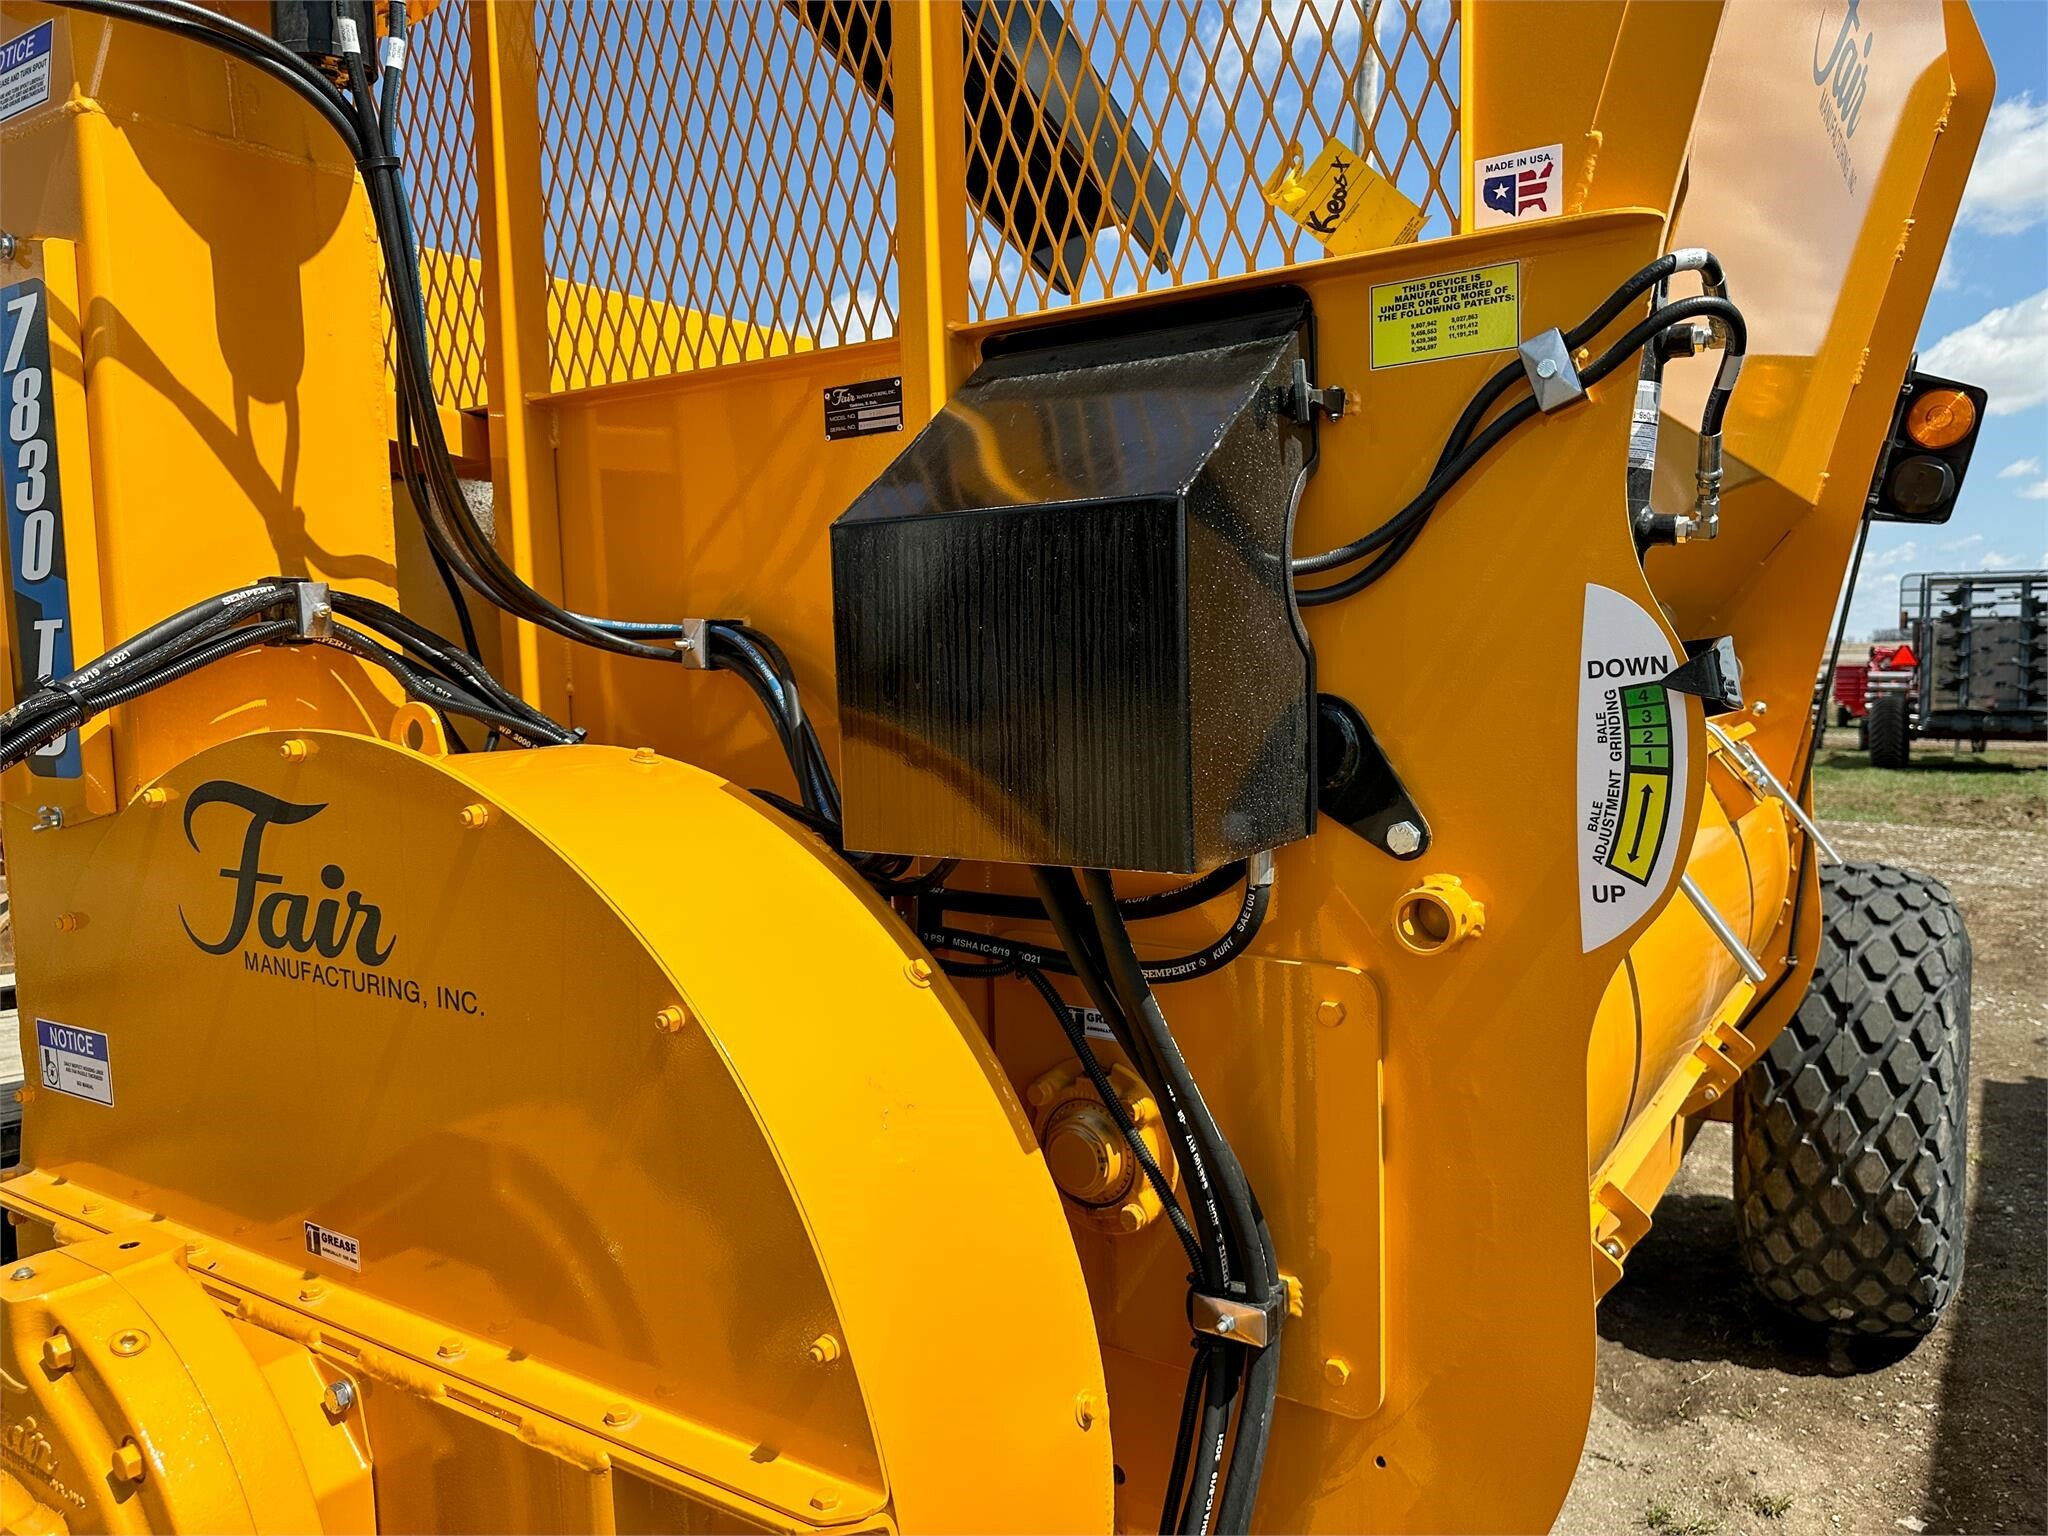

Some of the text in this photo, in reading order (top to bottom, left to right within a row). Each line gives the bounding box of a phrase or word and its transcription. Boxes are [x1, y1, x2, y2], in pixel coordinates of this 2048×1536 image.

[1486, 159, 1514, 173] MADE
[1516, 157, 1527, 167] IN
[1394, 279, 1493, 304] MANUFACTURERED
[1402, 273, 1481, 294] THIS DEVICE IS
[1377, 294, 1515, 323] THE FOLLOWING PATENTS:
[1380, 285, 1509, 314] UNDER ONE OR MORE OF
[831, 388, 855, 406] Fair
[2, 292, 55, 582] 7830
[106, 649, 132, 669] 3Q21
[1587, 655, 1669, 680] DOWN
[1637, 688, 1649, 703] 4
[1597, 711, 1608, 744] BALE
[1604, 688, 1623, 763] GRINDING
[1641, 709, 1652, 724] 3
[1643, 730, 1654, 744] 2
[1645, 750, 1653, 764] 1
[1588, 800, 1603, 833] BALE
[1592, 769, 1622, 866] ADJUSTMENT
[178, 780, 397, 966] Fair
[1592, 884, 1626, 903] UP
[930, 934, 945, 943] PSI
[952, 938, 978, 950] MSHA
[980, 943, 1010, 957] IC-8/19
[1141, 893, 1256, 979] SEMPERIT KURT SAE100
[244, 950, 485, 1017] MANUFACTURING, INC.
[49, 1026, 94, 1056] NOTICE
[321, 1232, 357, 1254] GREASE
